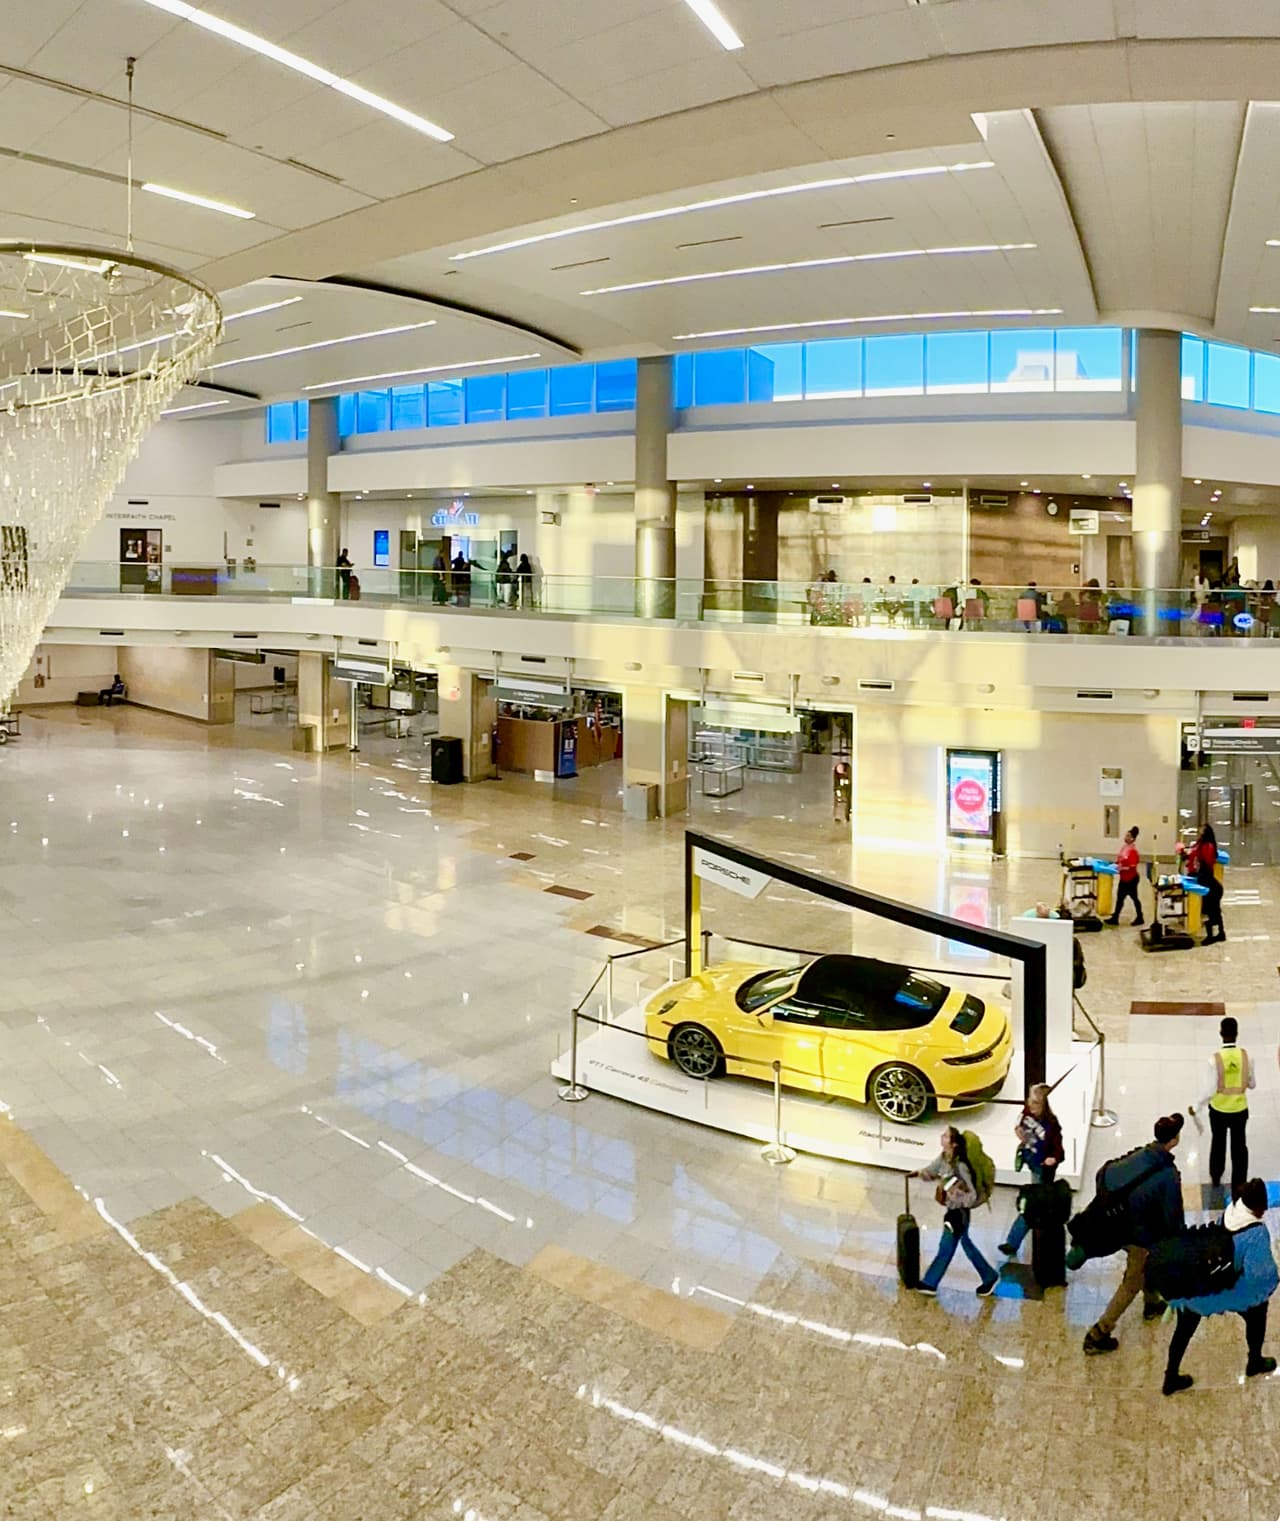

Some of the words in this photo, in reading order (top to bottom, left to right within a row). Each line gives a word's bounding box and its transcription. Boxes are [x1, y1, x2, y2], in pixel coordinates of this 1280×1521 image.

[701, 859, 751, 885] PORSCHE
[605, 1065, 636, 1078] Carrera
[894, 1137, 926, 1147] Yellow
